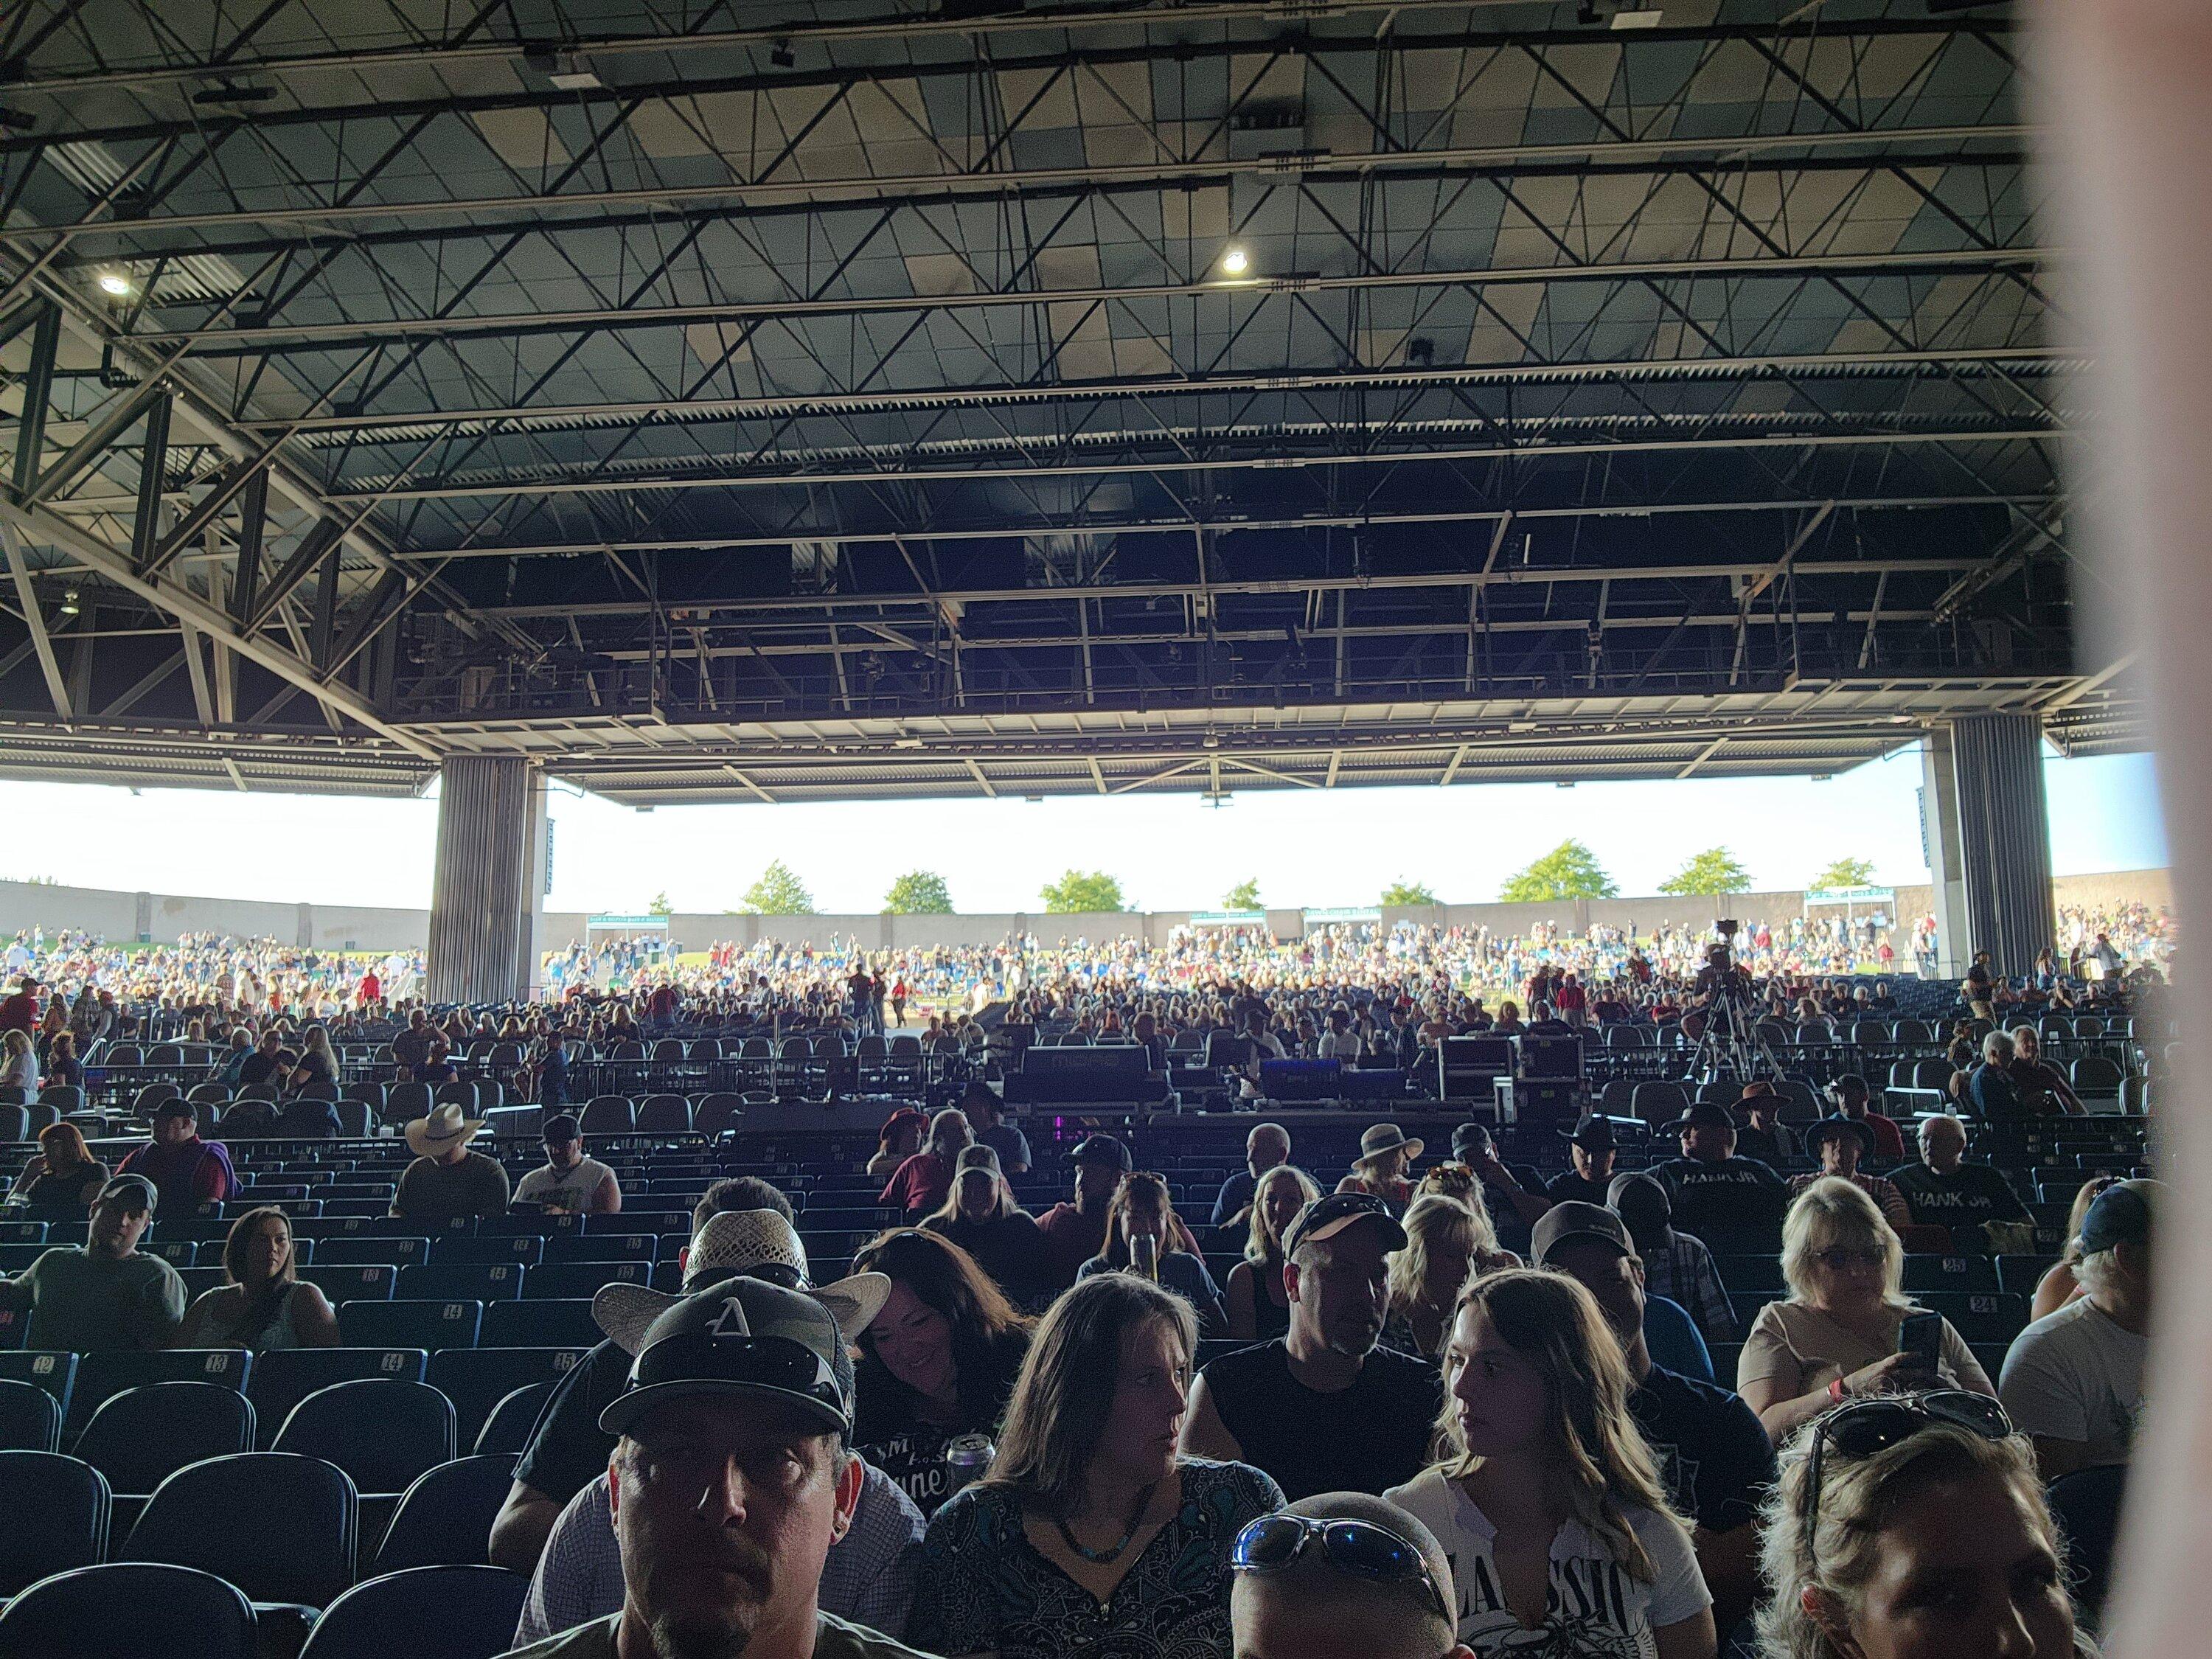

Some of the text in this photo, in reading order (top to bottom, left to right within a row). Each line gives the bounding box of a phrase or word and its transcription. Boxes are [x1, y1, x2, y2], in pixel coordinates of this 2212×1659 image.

[1913, 1191, 1964, 1208] HANK
[445, 1305, 461, 1318] 14
[1972, 1297, 1994, 1312] 24
[705, 1296, 751, 1337] A
[35, 1356, 53, 1374] 12
[206, 1355, 227, 1372] 13
[383, 1354, 403, 1371] 14
[555, 1354, 575, 1371] 15
